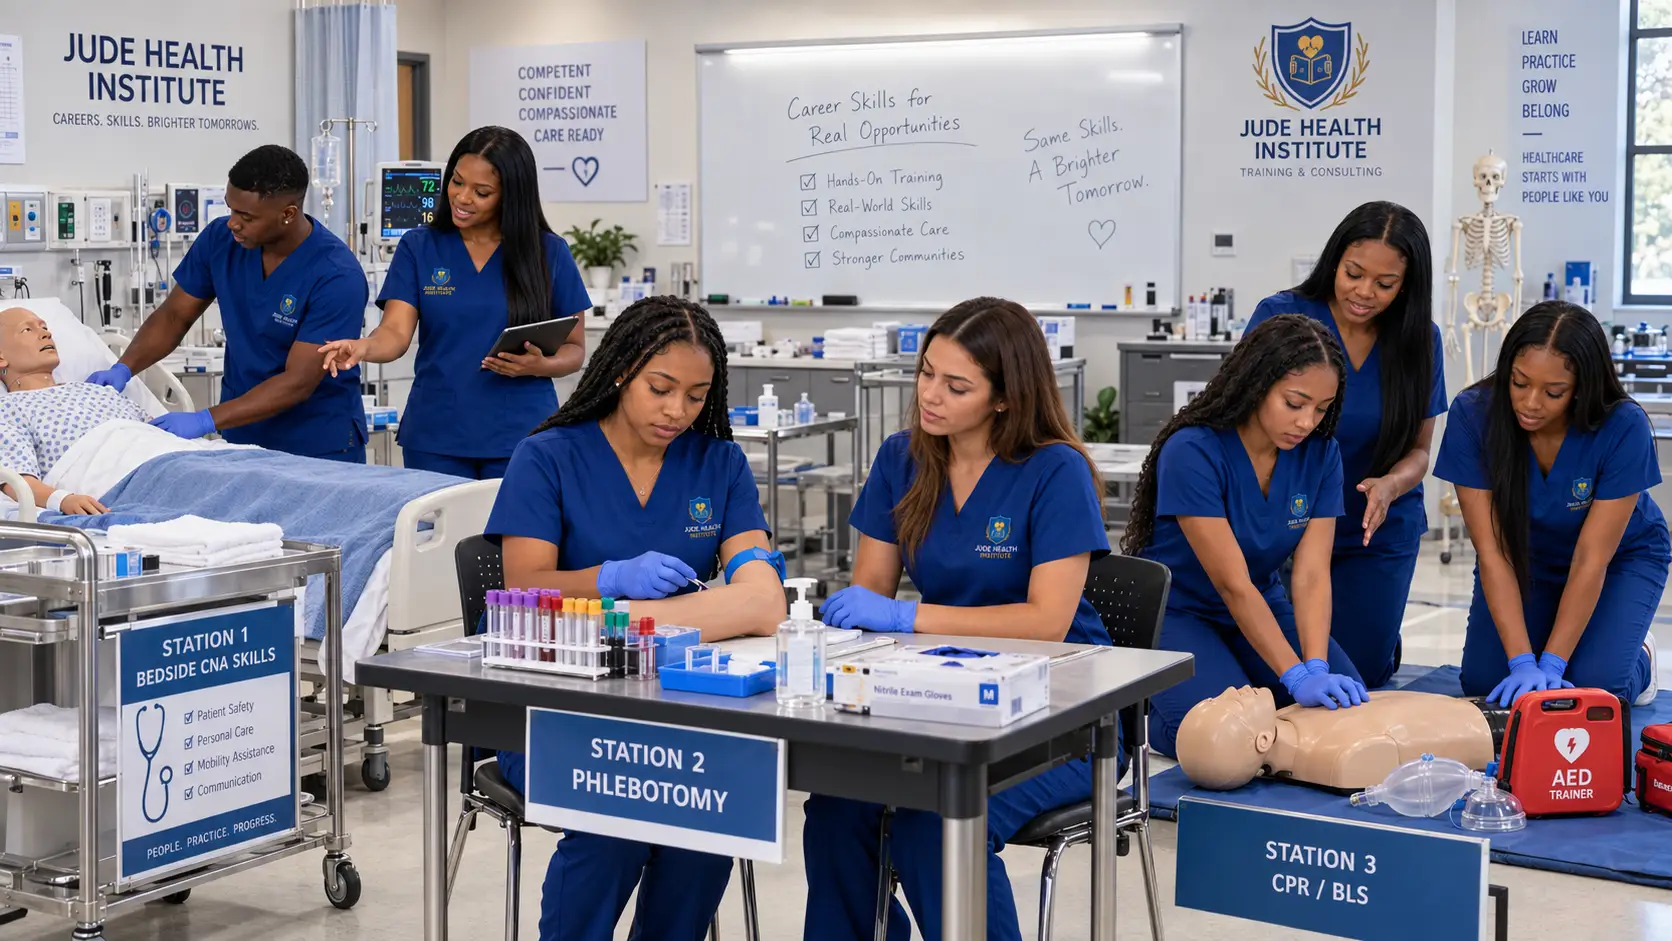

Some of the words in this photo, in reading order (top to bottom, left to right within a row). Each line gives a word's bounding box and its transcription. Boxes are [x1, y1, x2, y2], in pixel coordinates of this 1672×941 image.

[1523, 30, 1557, 45] LEARN
[64, 33, 135, 65] JUDE
[146, 39, 243, 72] HEALTH
[1522, 54, 1575, 69] PRACTICE
[518, 64, 591, 80] COMPETENT
[89, 71, 225, 105] INSTITUTE
[519, 85, 591, 101] CONFIDENT
[1523, 79, 1557, 93] GROW
[519, 105, 617, 121] COMPASSIONATE
[788, 97, 841, 120] Career
[851, 90, 895, 112] Skills
[907, 88, 932, 107] for
[1523, 103, 1569, 118] BELONG
[53, 113, 102, 126] CAREERS.
[107, 115, 143, 127] SKILLS.
[148, 116, 195, 128] BRIGHTER
[198, 118, 259, 130] TOMORROWS.
[1240, 119, 1291, 137] JUDE
[1301, 118, 1380, 136] HEALTH
[534, 129, 564, 142] CARE
[568, 128, 604, 142] READY
[809, 123, 847, 146] Real
[860, 116, 960, 143] Opportunities
[1024, 128, 1070, 152] Same
[1079, 116, 1123, 138] Skills.
[1256, 141, 1366, 159] INSTITUTE
[1523, 152, 1583, 163] HEALTHCARE
[1029, 160, 1042, 183] A
[1052, 148, 1119, 178] Brighter
[1240, 168, 1292, 177] TRAINING
[1298, 168, 1305, 177] &
[1311, 166, 1382, 176] CONSULTING
[421, 180, 434, 192] 72
[828, 173, 882, 188] Hands-On
[890, 169, 943, 191] Training
[1522, 171, 1558, 183] STARTS
[1562, 171, 1586, 182] WITH
[1057, 175, 1148, 205] Tomorrow.
[1523, 191, 1559, 202] PEOPLE
[1563, 191, 1584, 202] LIKE
[1588, 191, 1608, 202] YOU
[422, 197, 434, 209] 98
[829, 198, 893, 214] Real-World
[901, 197, 932, 211] Skills
[422, 211, 433, 223] 16
[831, 224, 913, 244] Compassionate
[921, 221, 949, 236] Care
[833, 251, 883, 270] Stronger
[890, 248, 964, 263] Communities
[163, 629, 234, 657] STATION
[241, 627, 247, 642] 1
[137, 662, 196, 687] BEDSIDE
[201, 656, 228, 673] CNA
[233, 647, 275, 667] SKILLS
[874, 685, 898, 696] Nitrile
[900, 688, 922, 697] Exam
[924, 690, 952, 700] Gloves
[984, 689, 994, 700] M
[198, 707, 225, 721] Patient
[229, 701, 254, 714] Safety
[198, 728, 232, 746] Personal
[235, 726, 253, 737] Care
[198, 755, 230, 771] Mobility
[233, 745, 274, 762] Assistance
[591, 738, 682, 769] STATION
[693, 752, 704, 773] 2
[198, 771, 261, 796] Communication
[1552, 769, 1592, 786] AED
[573, 769, 728, 813] PHLEBOTOMY
[1549, 789, 1593, 799] TRAINER
[147, 841, 183, 859] PEOPLE.
[187, 826, 230, 847] PRACTICE.
[233, 813, 277, 833] PROGRESS.
[1266, 841, 1354, 871] STATION
[1364, 855, 1376, 874] 3
[1273, 874, 1309, 896] CPR
[1316, 880, 1325, 900] /
[1333, 882, 1368, 904] BLS
